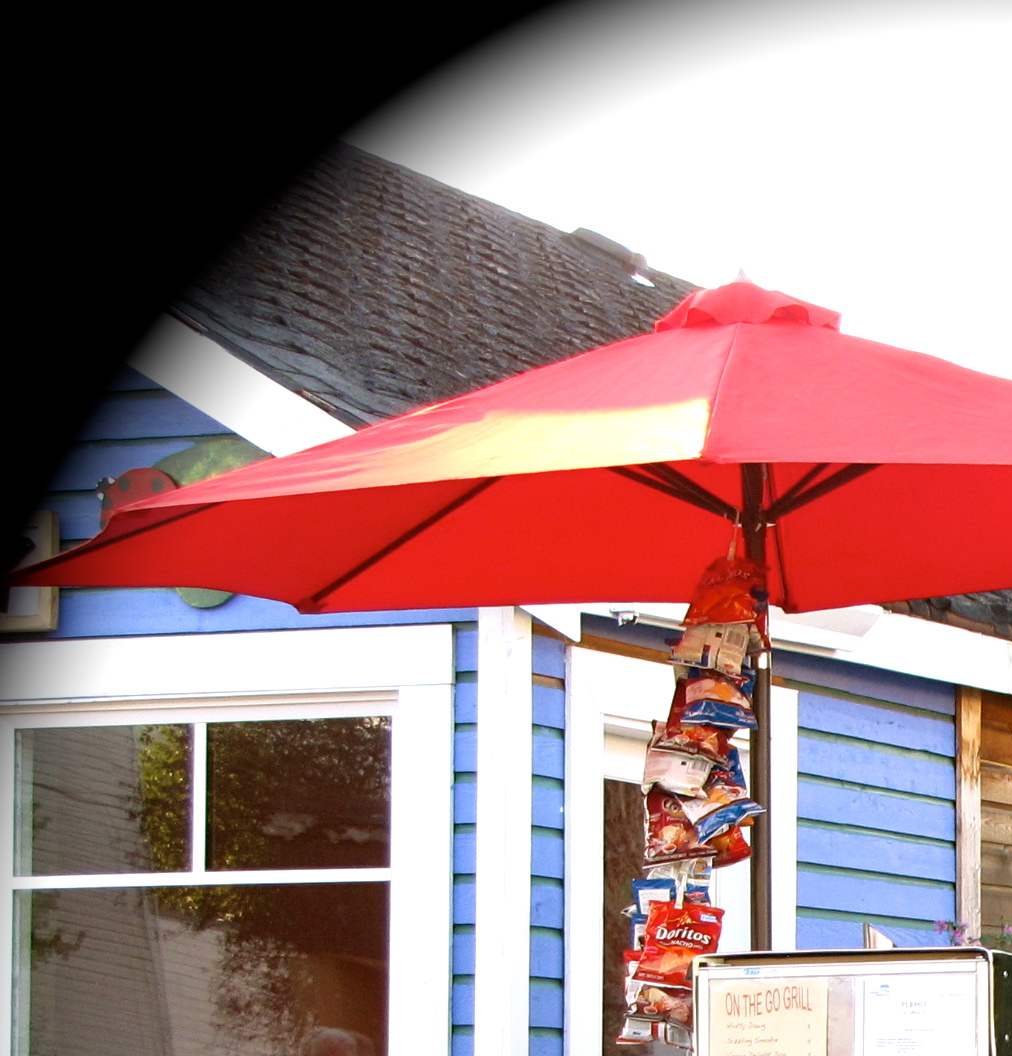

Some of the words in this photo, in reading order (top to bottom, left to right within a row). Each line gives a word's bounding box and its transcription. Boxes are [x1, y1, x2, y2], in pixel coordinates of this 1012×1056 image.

[655, 926, 711, 945] Doritos
[725, 992, 740, 1017] ON
[743, 992, 763, 1017] THE
[765, 987, 781, 1013] GO
[783, 986, 812, 1011] GRILL
